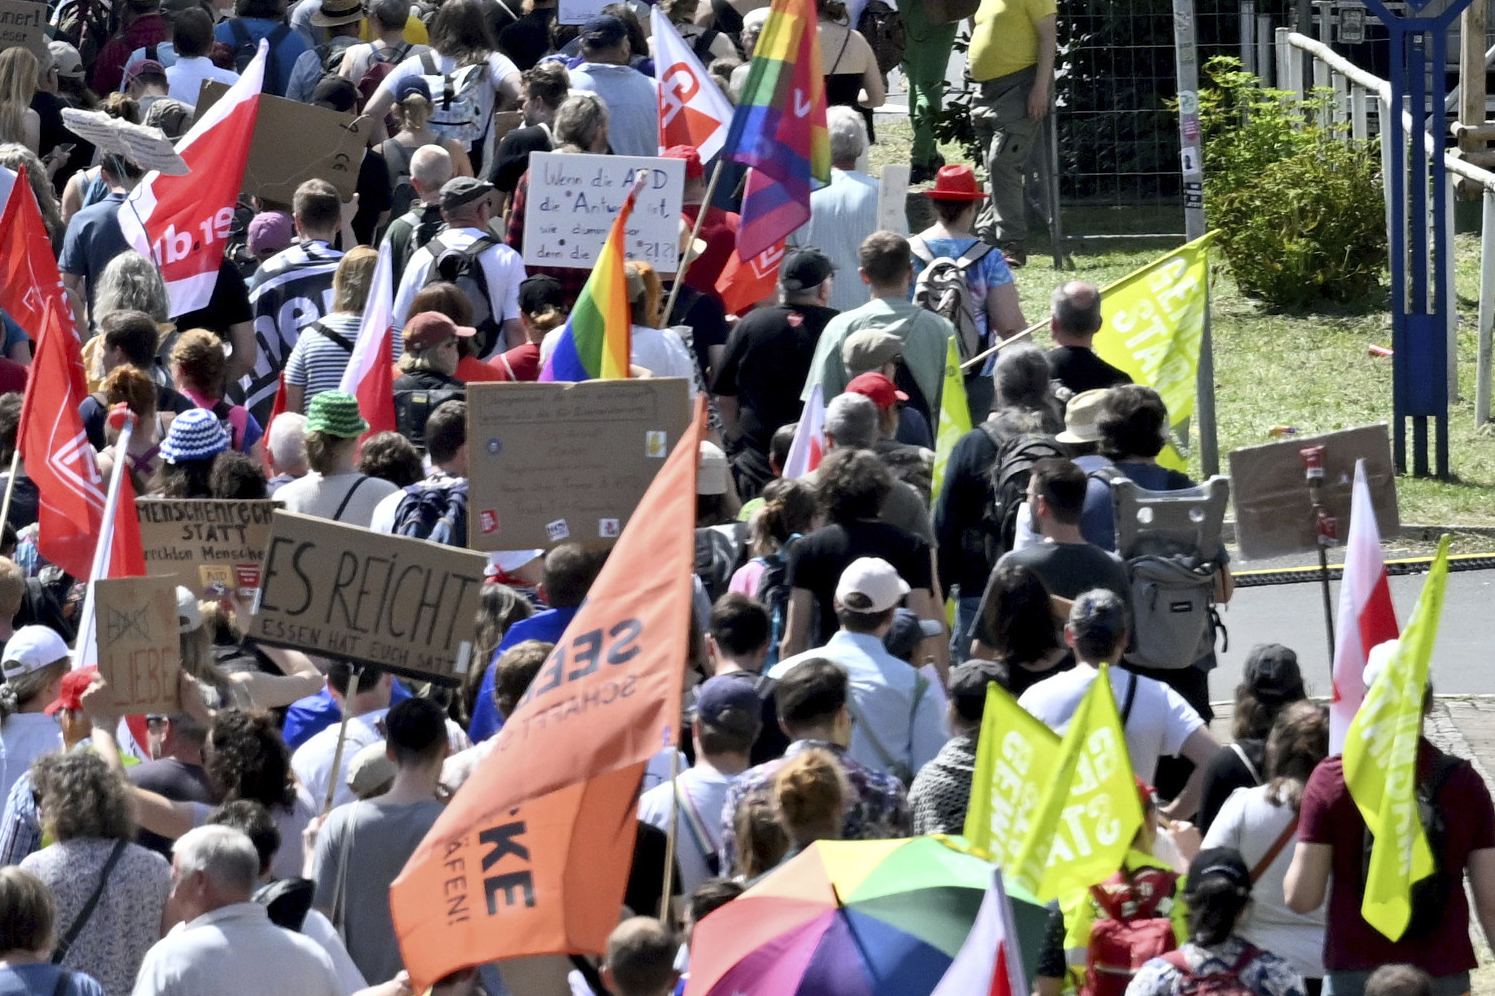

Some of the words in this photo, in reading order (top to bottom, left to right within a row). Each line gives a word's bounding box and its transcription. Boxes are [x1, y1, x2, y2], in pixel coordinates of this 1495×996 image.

[544, 161, 583, 187] Wenn
[590, 167, 613, 188] die
[539, 196, 561, 212] die
[570, 244, 591, 260] die
[182, 524, 249, 546] STATT
[201, 546, 266, 563] Mensche
[259, 535, 317, 618] ES
[326, 550, 481, 652] REICHT
[261, 619, 322, 644] ESSEN
[329, 632, 362, 652] HAT
[369, 642, 411, 662] EUCH
[109, 645, 175, 707] LIEBE
[442, 838, 471, 927] ÄFEN!
